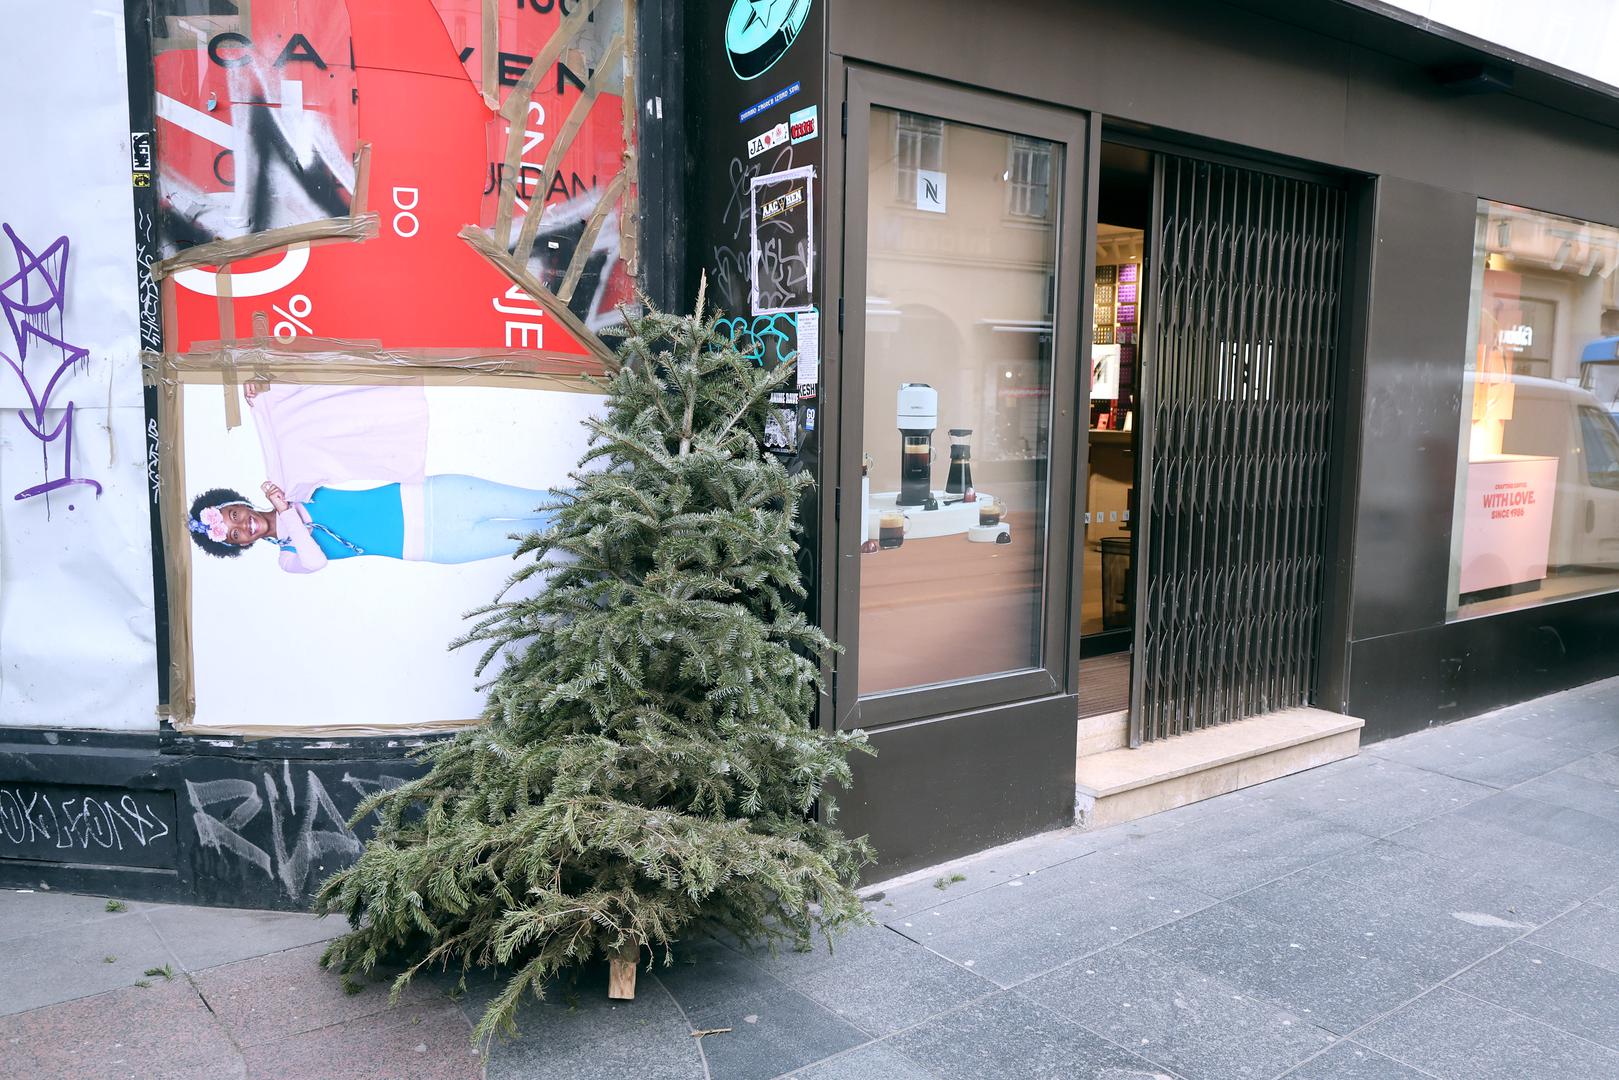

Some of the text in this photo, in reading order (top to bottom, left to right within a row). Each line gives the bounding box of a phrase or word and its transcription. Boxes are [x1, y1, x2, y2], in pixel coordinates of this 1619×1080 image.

[393, 187, 419, 237] DO
[1483, 493, 1509, 508] WITH
[1491, 509, 1510, 519] SINCE
